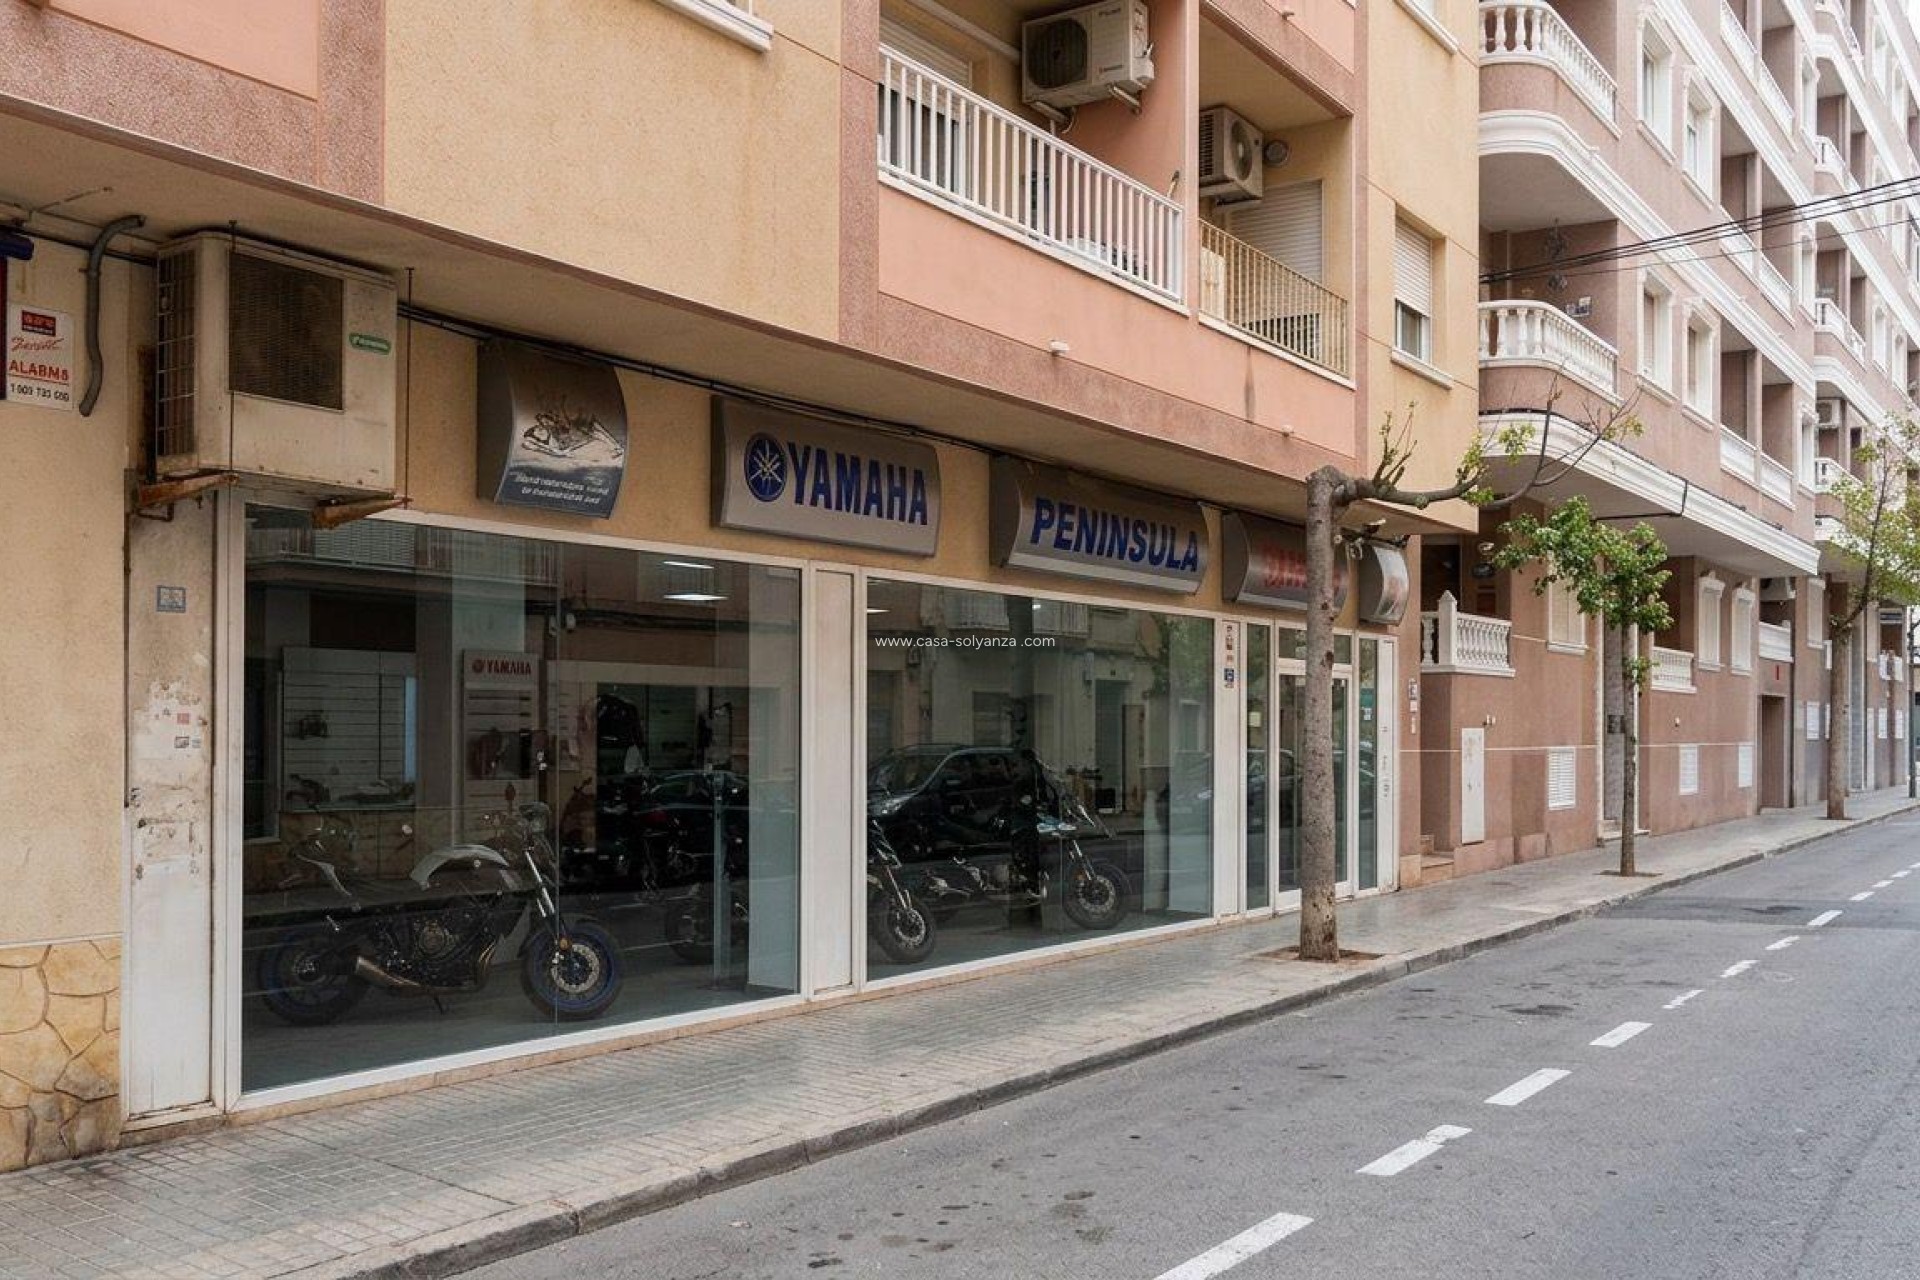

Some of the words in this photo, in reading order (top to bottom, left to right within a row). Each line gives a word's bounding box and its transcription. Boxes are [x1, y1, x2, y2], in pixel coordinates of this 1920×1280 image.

[787, 442, 928, 526] YAMAHA
[1030, 497, 1198, 572] PENINSULA
[487, 659, 532, 675] YAMAHA
